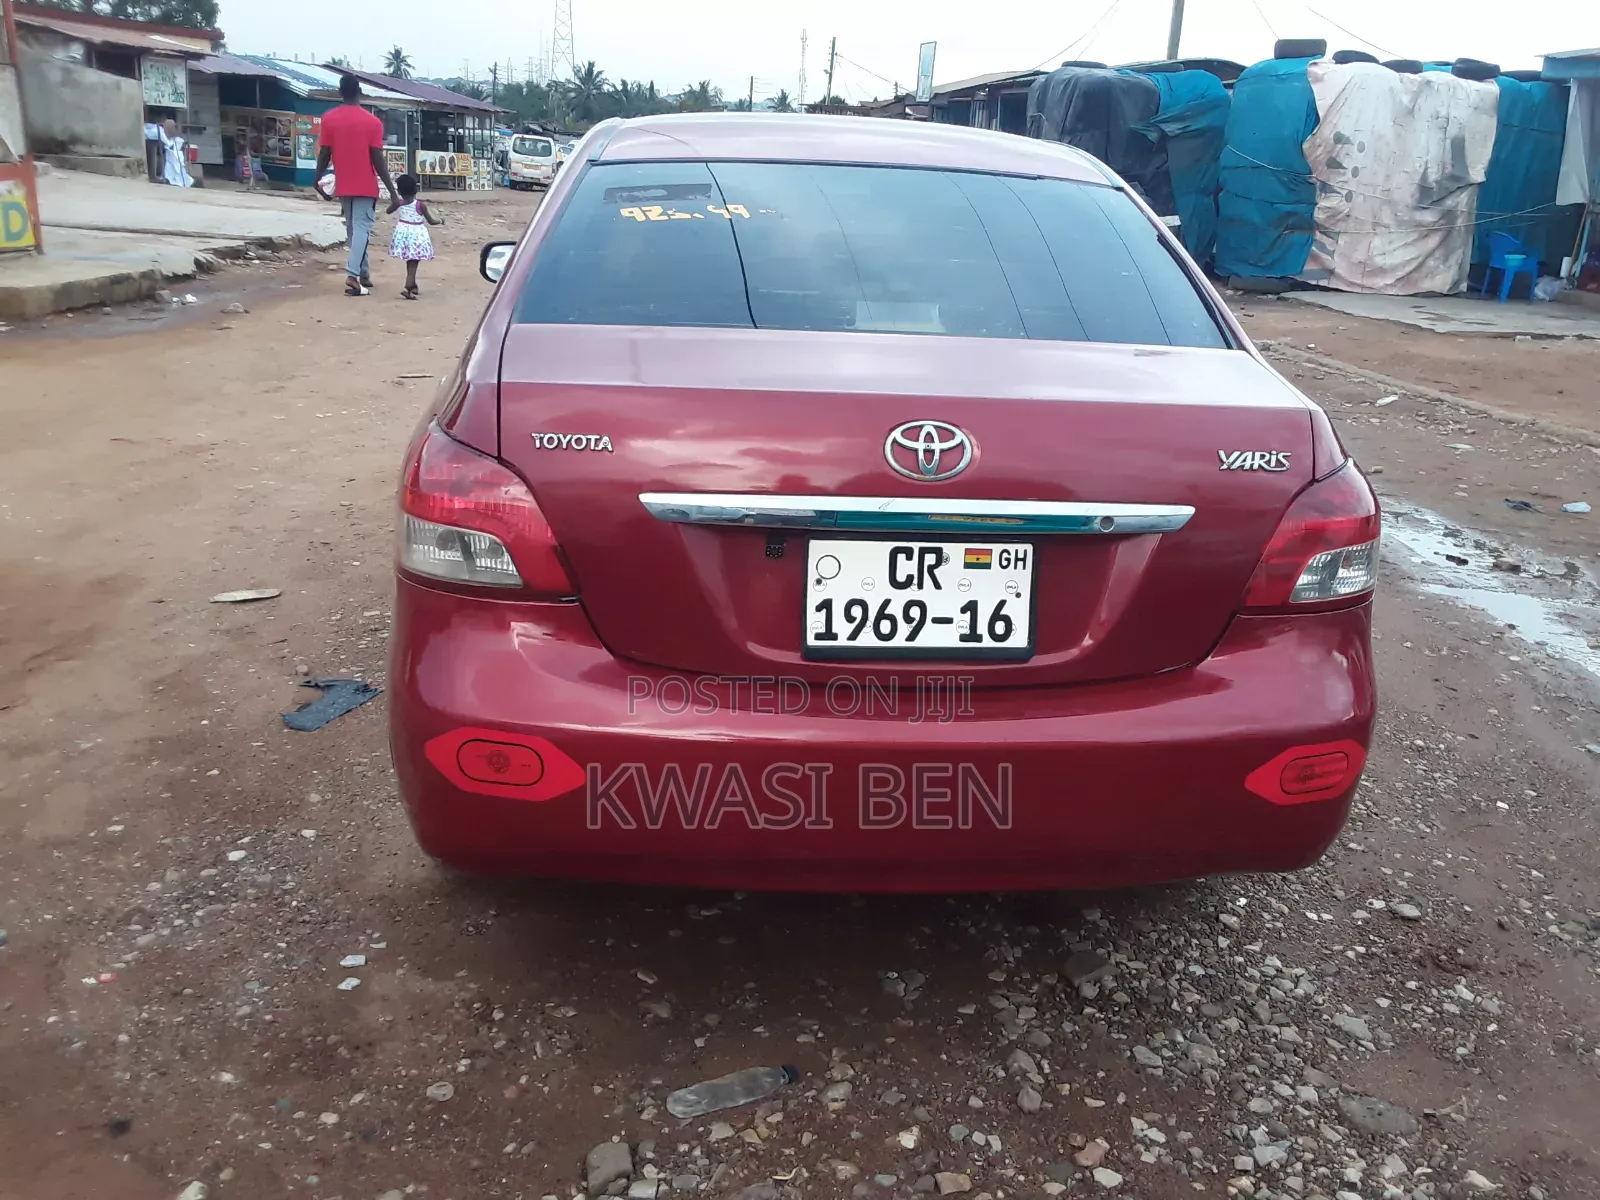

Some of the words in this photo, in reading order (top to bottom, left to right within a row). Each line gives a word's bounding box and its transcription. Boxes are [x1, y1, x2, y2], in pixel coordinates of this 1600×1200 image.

[531, 432, 613, 452] TOYOTA
[888, 545, 943, 591] CR
[998, 548, 1028, 570] GH
[814, 597, 1013, 643] 1969-16
